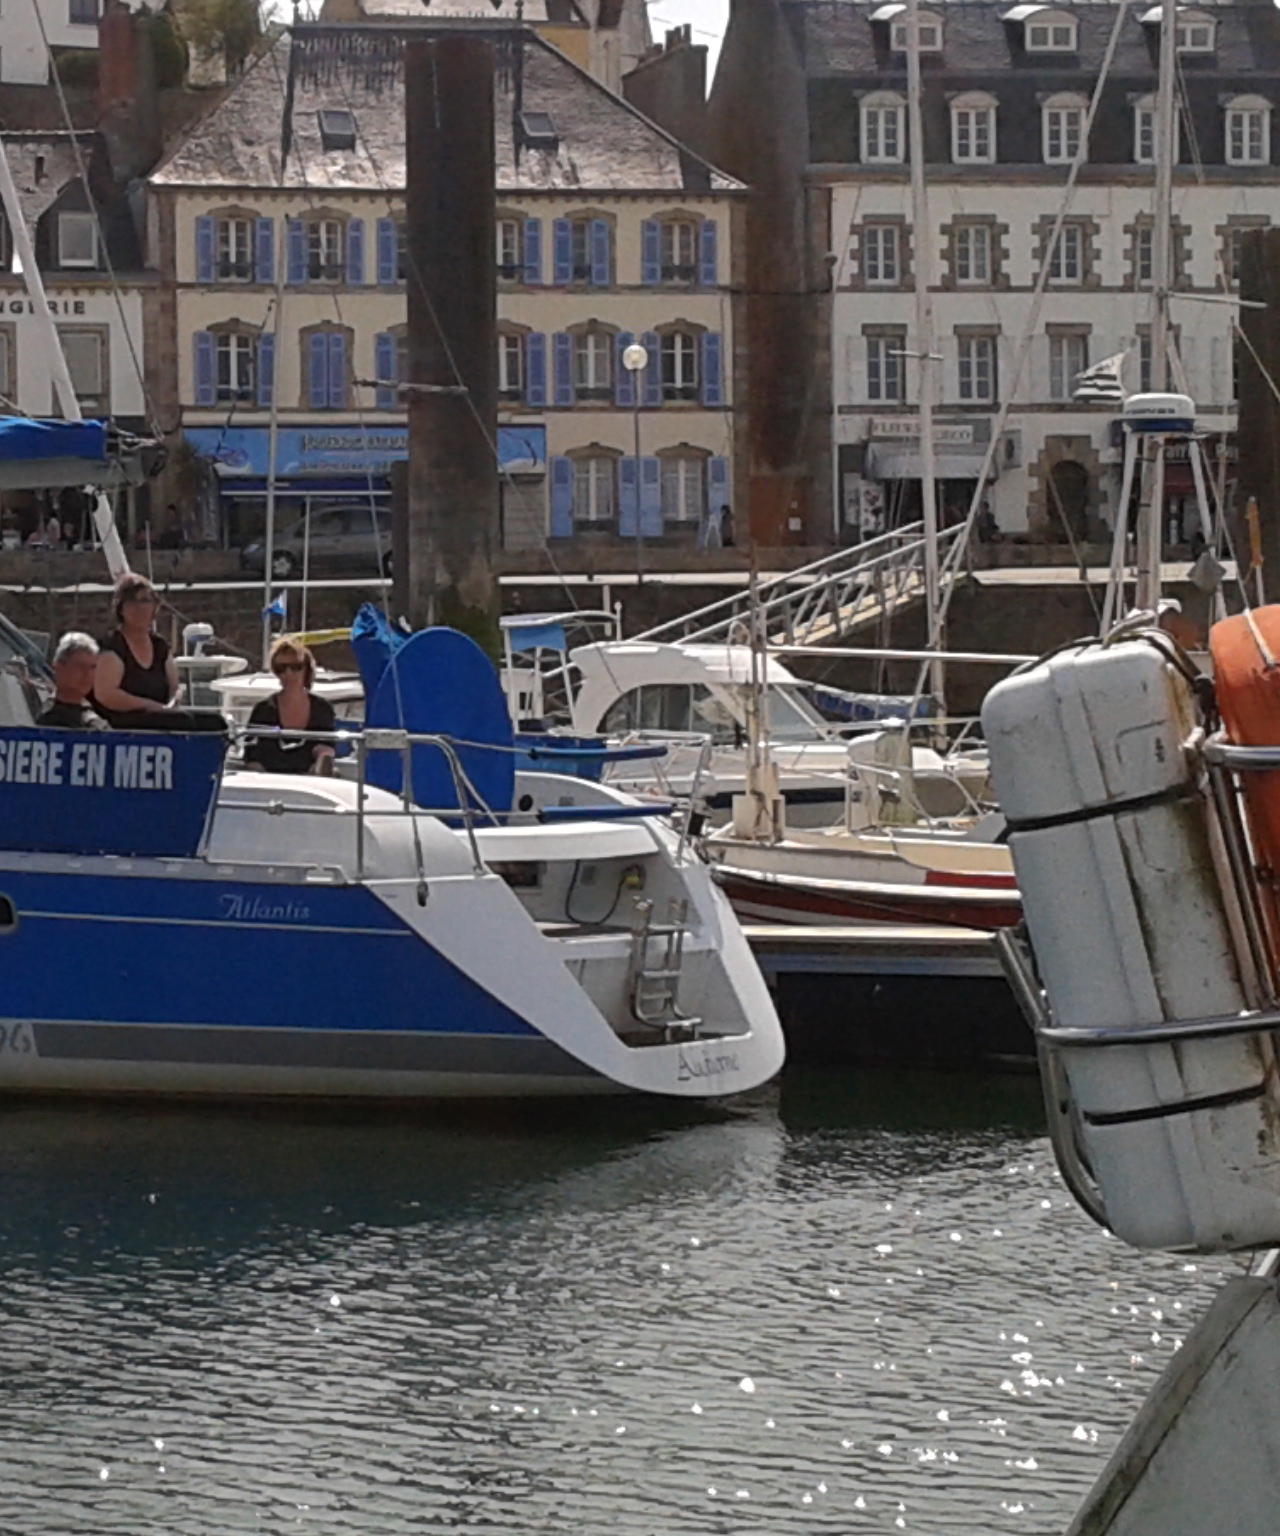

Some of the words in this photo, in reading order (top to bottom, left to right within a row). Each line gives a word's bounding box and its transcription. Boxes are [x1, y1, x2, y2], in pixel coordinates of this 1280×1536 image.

[69, 741, 108, 788] EN
[113, 744, 174, 790] MER
[219, 893, 311, 919] Atlantis
